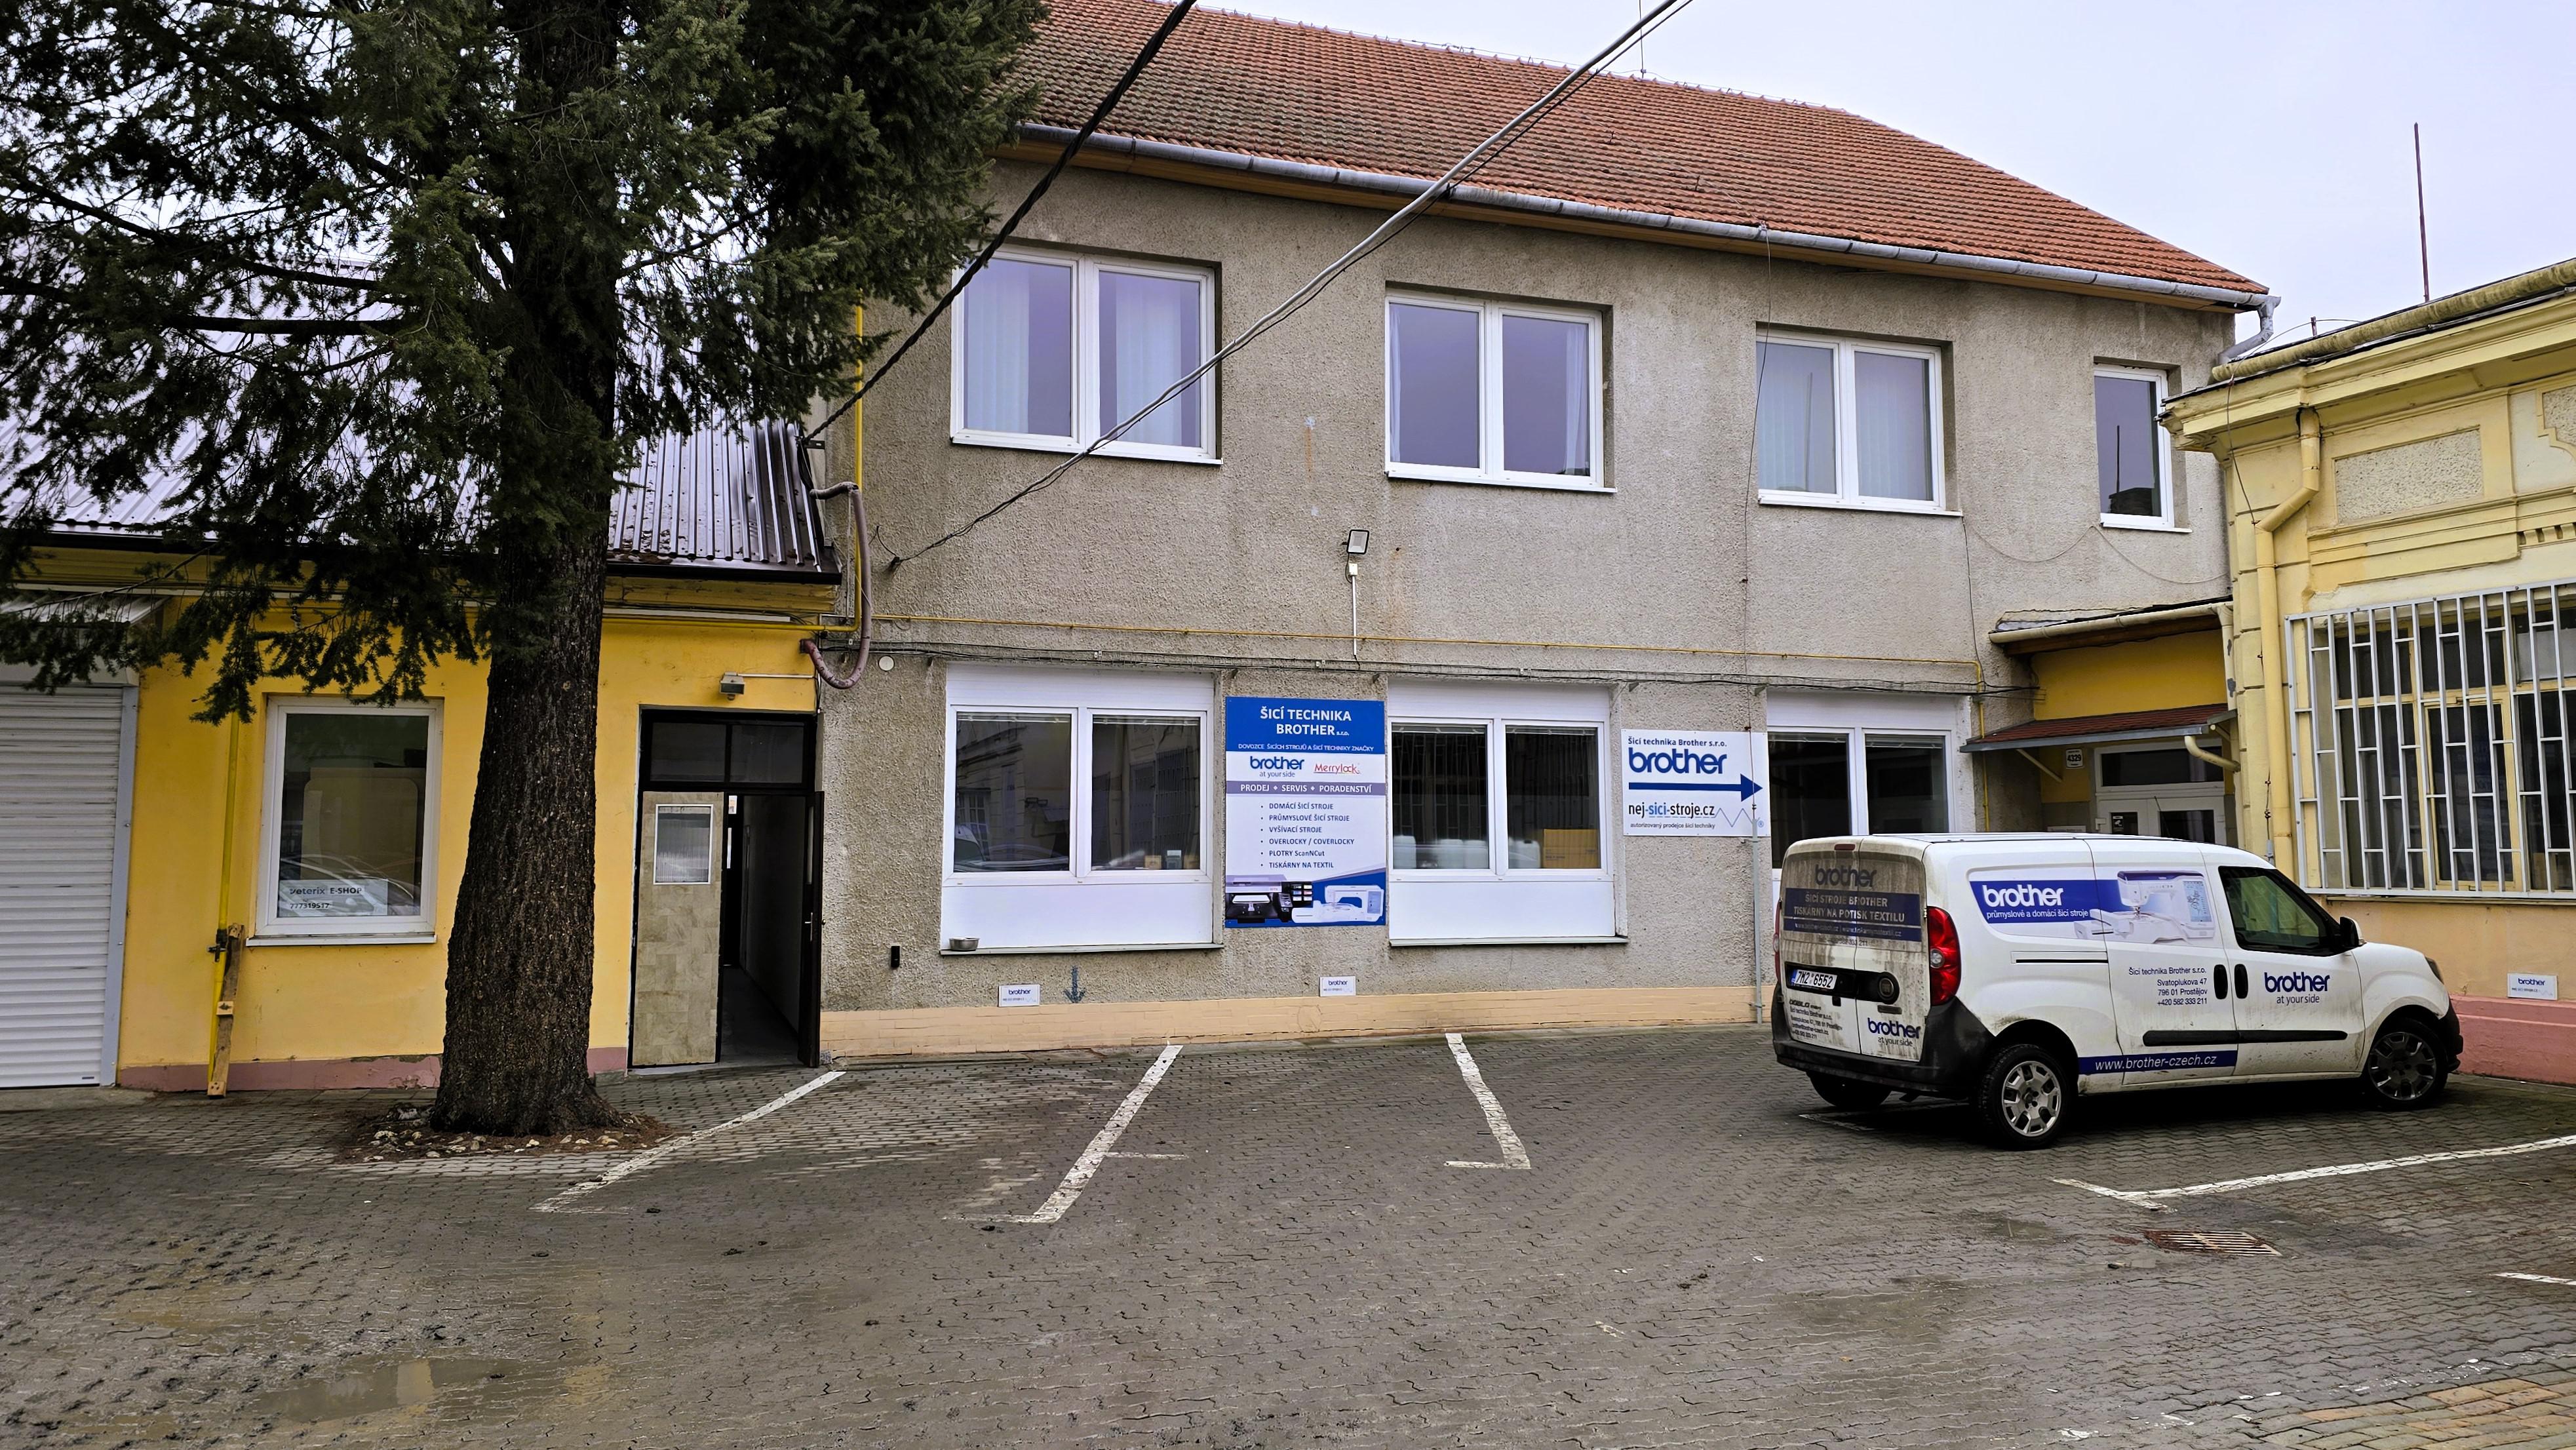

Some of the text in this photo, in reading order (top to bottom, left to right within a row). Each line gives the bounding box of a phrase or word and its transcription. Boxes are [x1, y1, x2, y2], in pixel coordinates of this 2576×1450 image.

[1260, 706, 1352, 721] ŠICÍ TECHNIKA
[1276, 724, 1335, 735] BROTHER
[1628, 735, 1641, 745] Šicí
[1250, 756, 1304, 770] brother
[1628, 747, 1727, 774] brother
[1314, 763, 1358, 775] Merrylock
[1319, 784, 1372, 793] PORADENSTVÍ
[1628, 802, 1715, 819] nej-sici-stroje.cz
[1815, 864, 1877, 888] brother
[1805, 891, 1888, 907] ŠICÍ STROJE BROTHER
[1982, 884, 2063, 907] brother
[1827, 908, 1837, 917] NA
[1839, 909, 1867, 920] POTISK
[1869, 911, 1905, 922] TEXTILU
[2070, 909, 2088, 918] stroje
[1813, 973, 1833, 988] 6552
[2265, 971, 2330, 992] brother
[2276, 994, 2320, 1006] at your side
[1867, 1017, 1921, 1039] brother
[1900, 1038, 1913, 1047] side
[2095, 1053, 2217, 1070] www.brother-czech.cz
